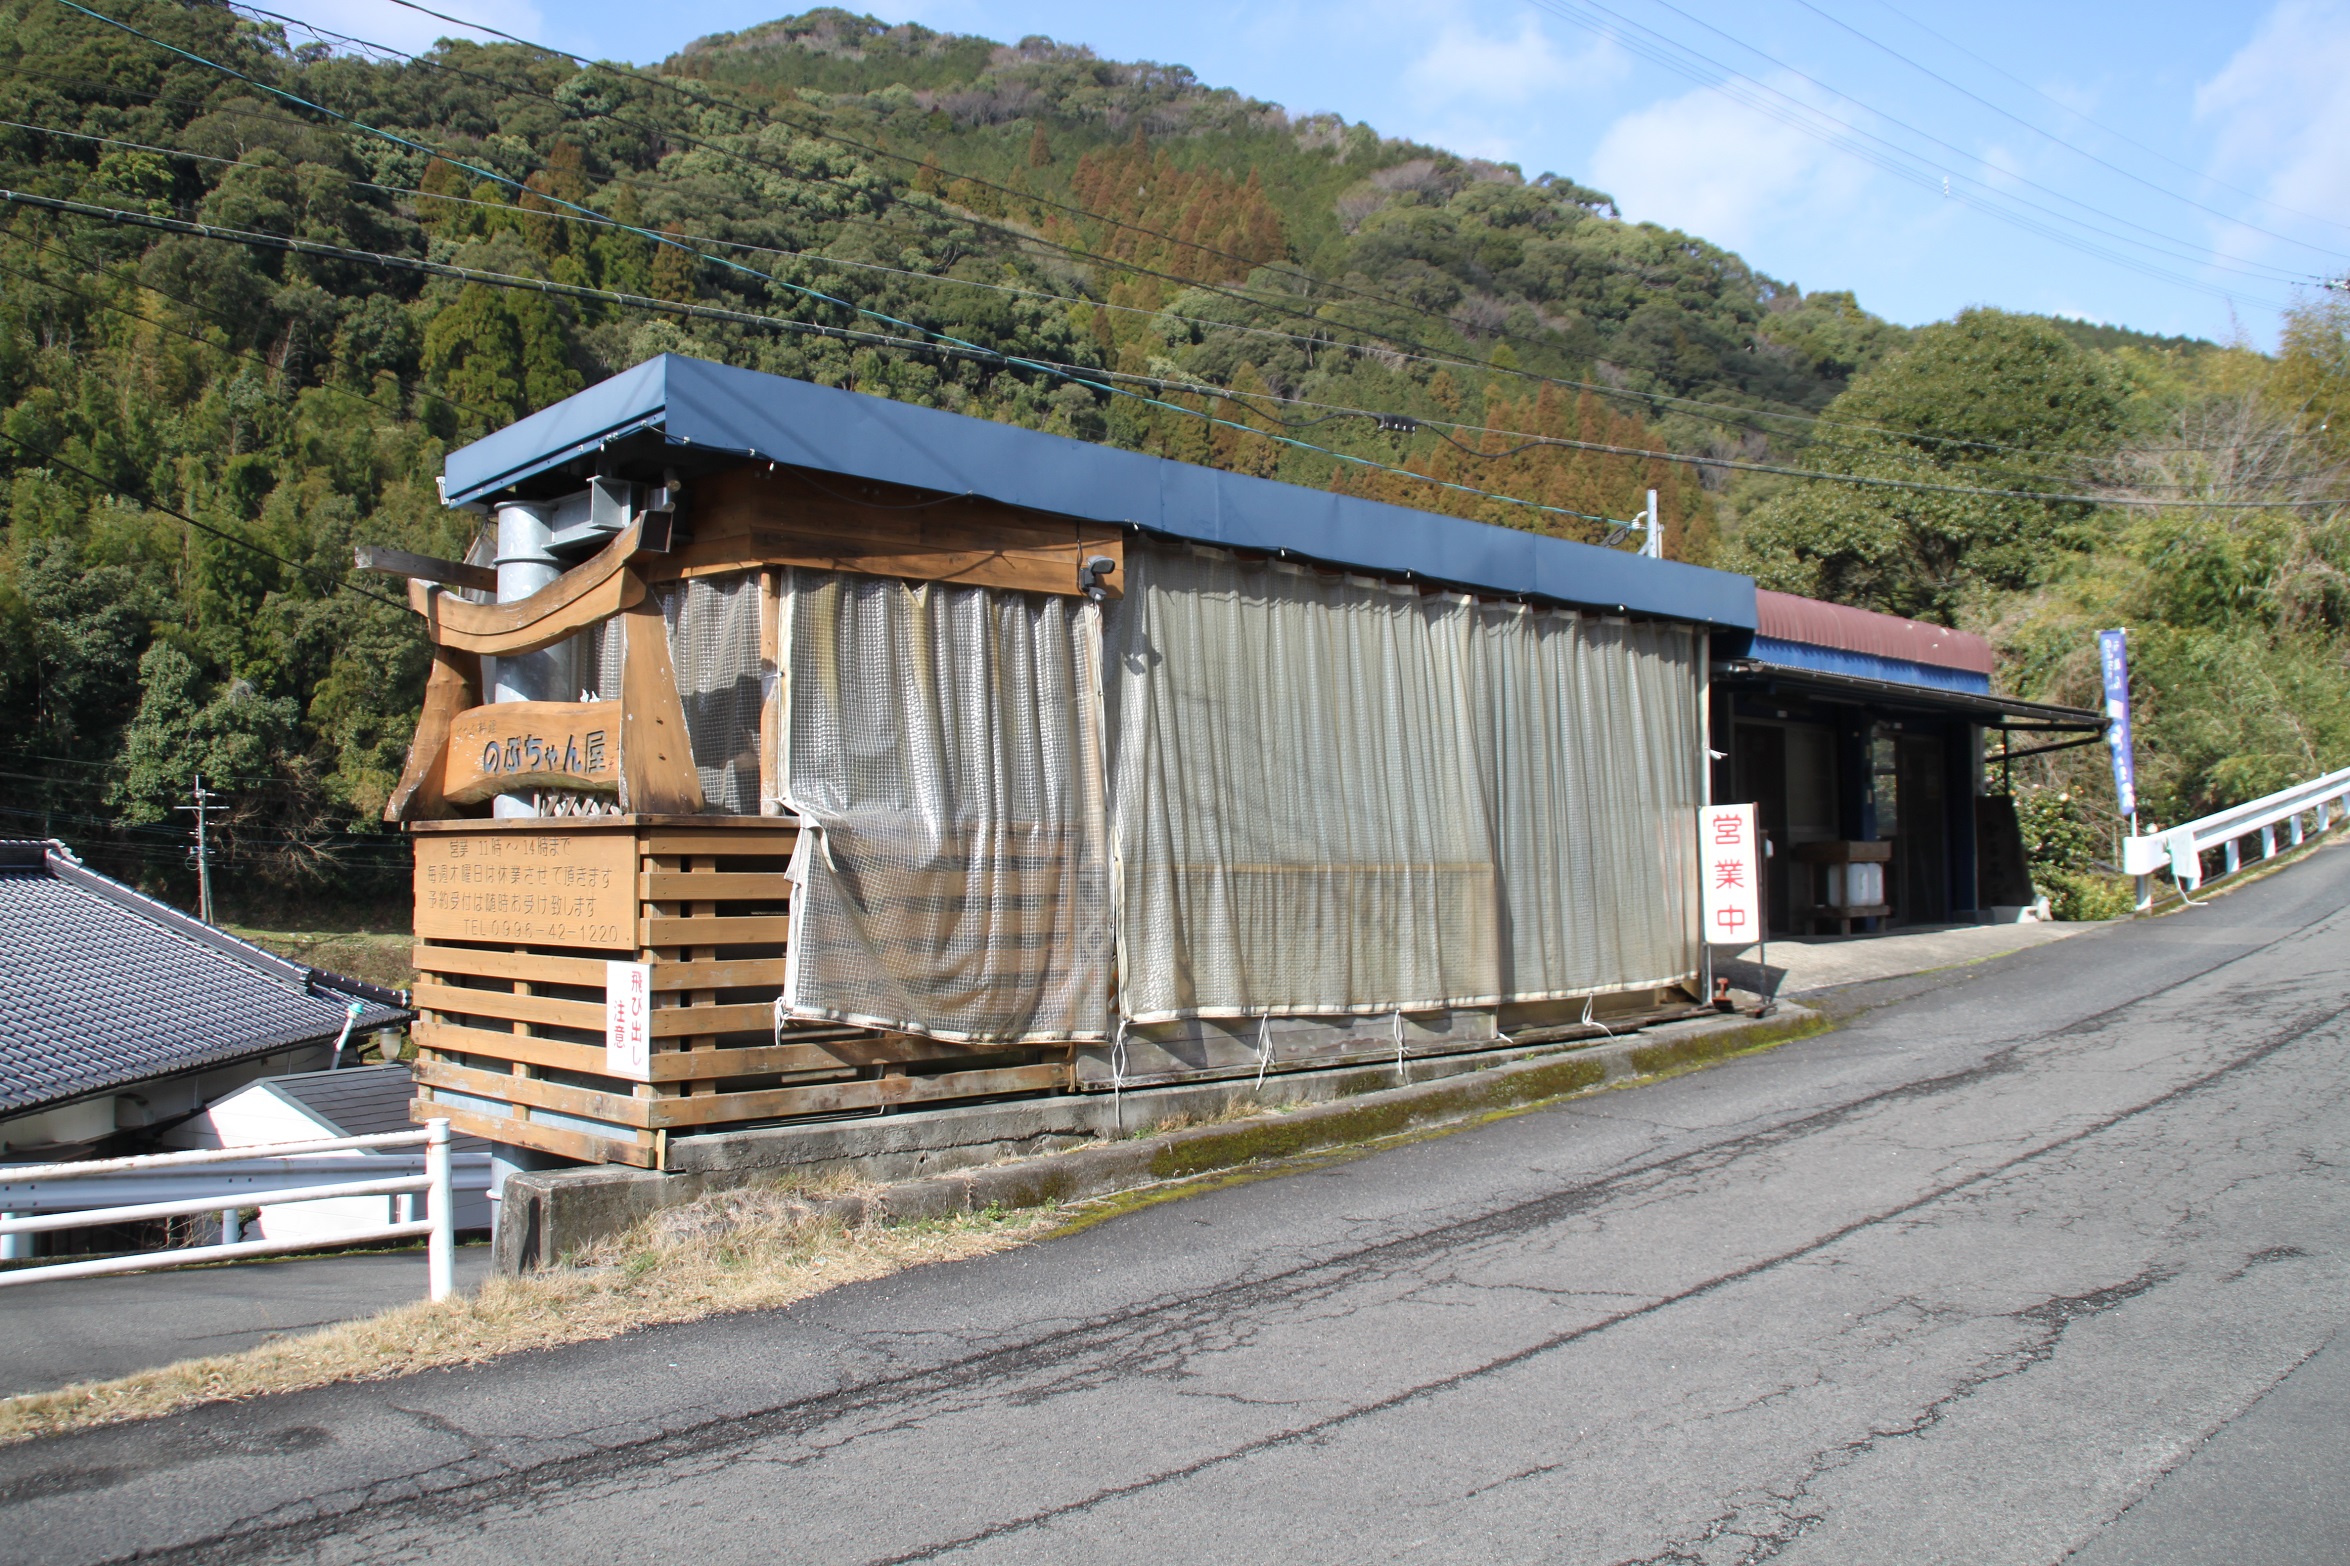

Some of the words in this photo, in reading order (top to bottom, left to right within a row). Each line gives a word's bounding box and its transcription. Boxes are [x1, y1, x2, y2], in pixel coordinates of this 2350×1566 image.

[483, 730, 605, 774] のぶちゃん屋
[427, 864, 612, 889] 毎週木曜日は休業させて頂きます
[1713, 814, 1745, 934] 営業中
[428, 890, 597, 917] 予約受付は随時お受け致します
[613, 1000, 626, 1049] 注意
[631, 970, 643, 1066] 飛び出し
